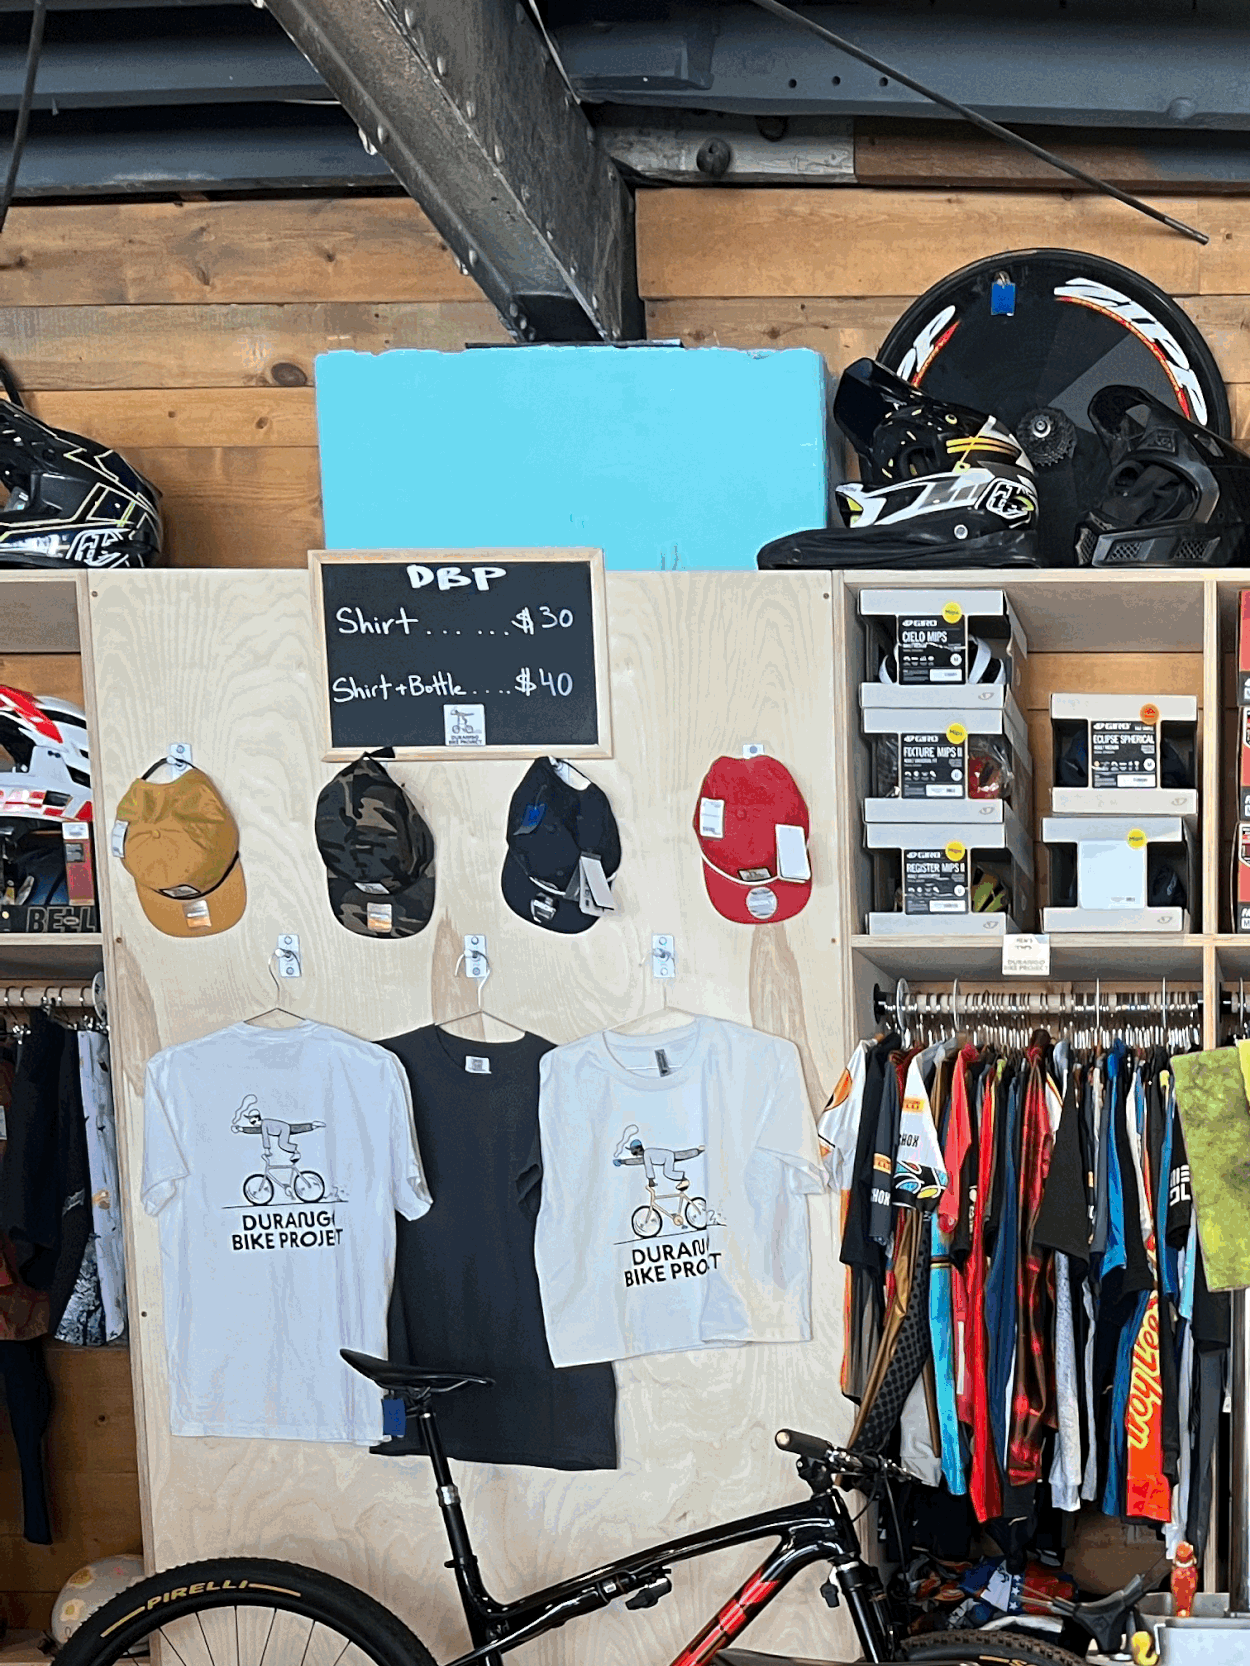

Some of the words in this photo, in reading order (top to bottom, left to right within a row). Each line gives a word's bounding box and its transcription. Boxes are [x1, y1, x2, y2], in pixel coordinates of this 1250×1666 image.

[406, 564, 506, 591] DBP
[335, 607, 419, 635] Shirt
[511, 606, 574, 635] $30
[902, 631, 926, 643] CIELO
[927, 631, 948, 643] MIPS
[514, 667, 573, 696] $40
[1093, 734, 1120, 744] ECLIPSE
[1120, 734, 1155, 744] SPHERICAL
[903, 747, 935, 758] FIXTURE
[936, 747, 956, 758] MIPS
[906, 863, 940, 873] REGISTER
[941, 863, 960, 873] MIPS
[242, 1209, 336, 1231] DURANG
[231, 1231, 275, 1251] BIKE
[280, 1228, 344, 1248] PROJET
[632, 1237, 709, 1266] DURAN
[624, 1265, 667, 1288] BIKE
[146, 1580, 249, 1610] PIRELLI
